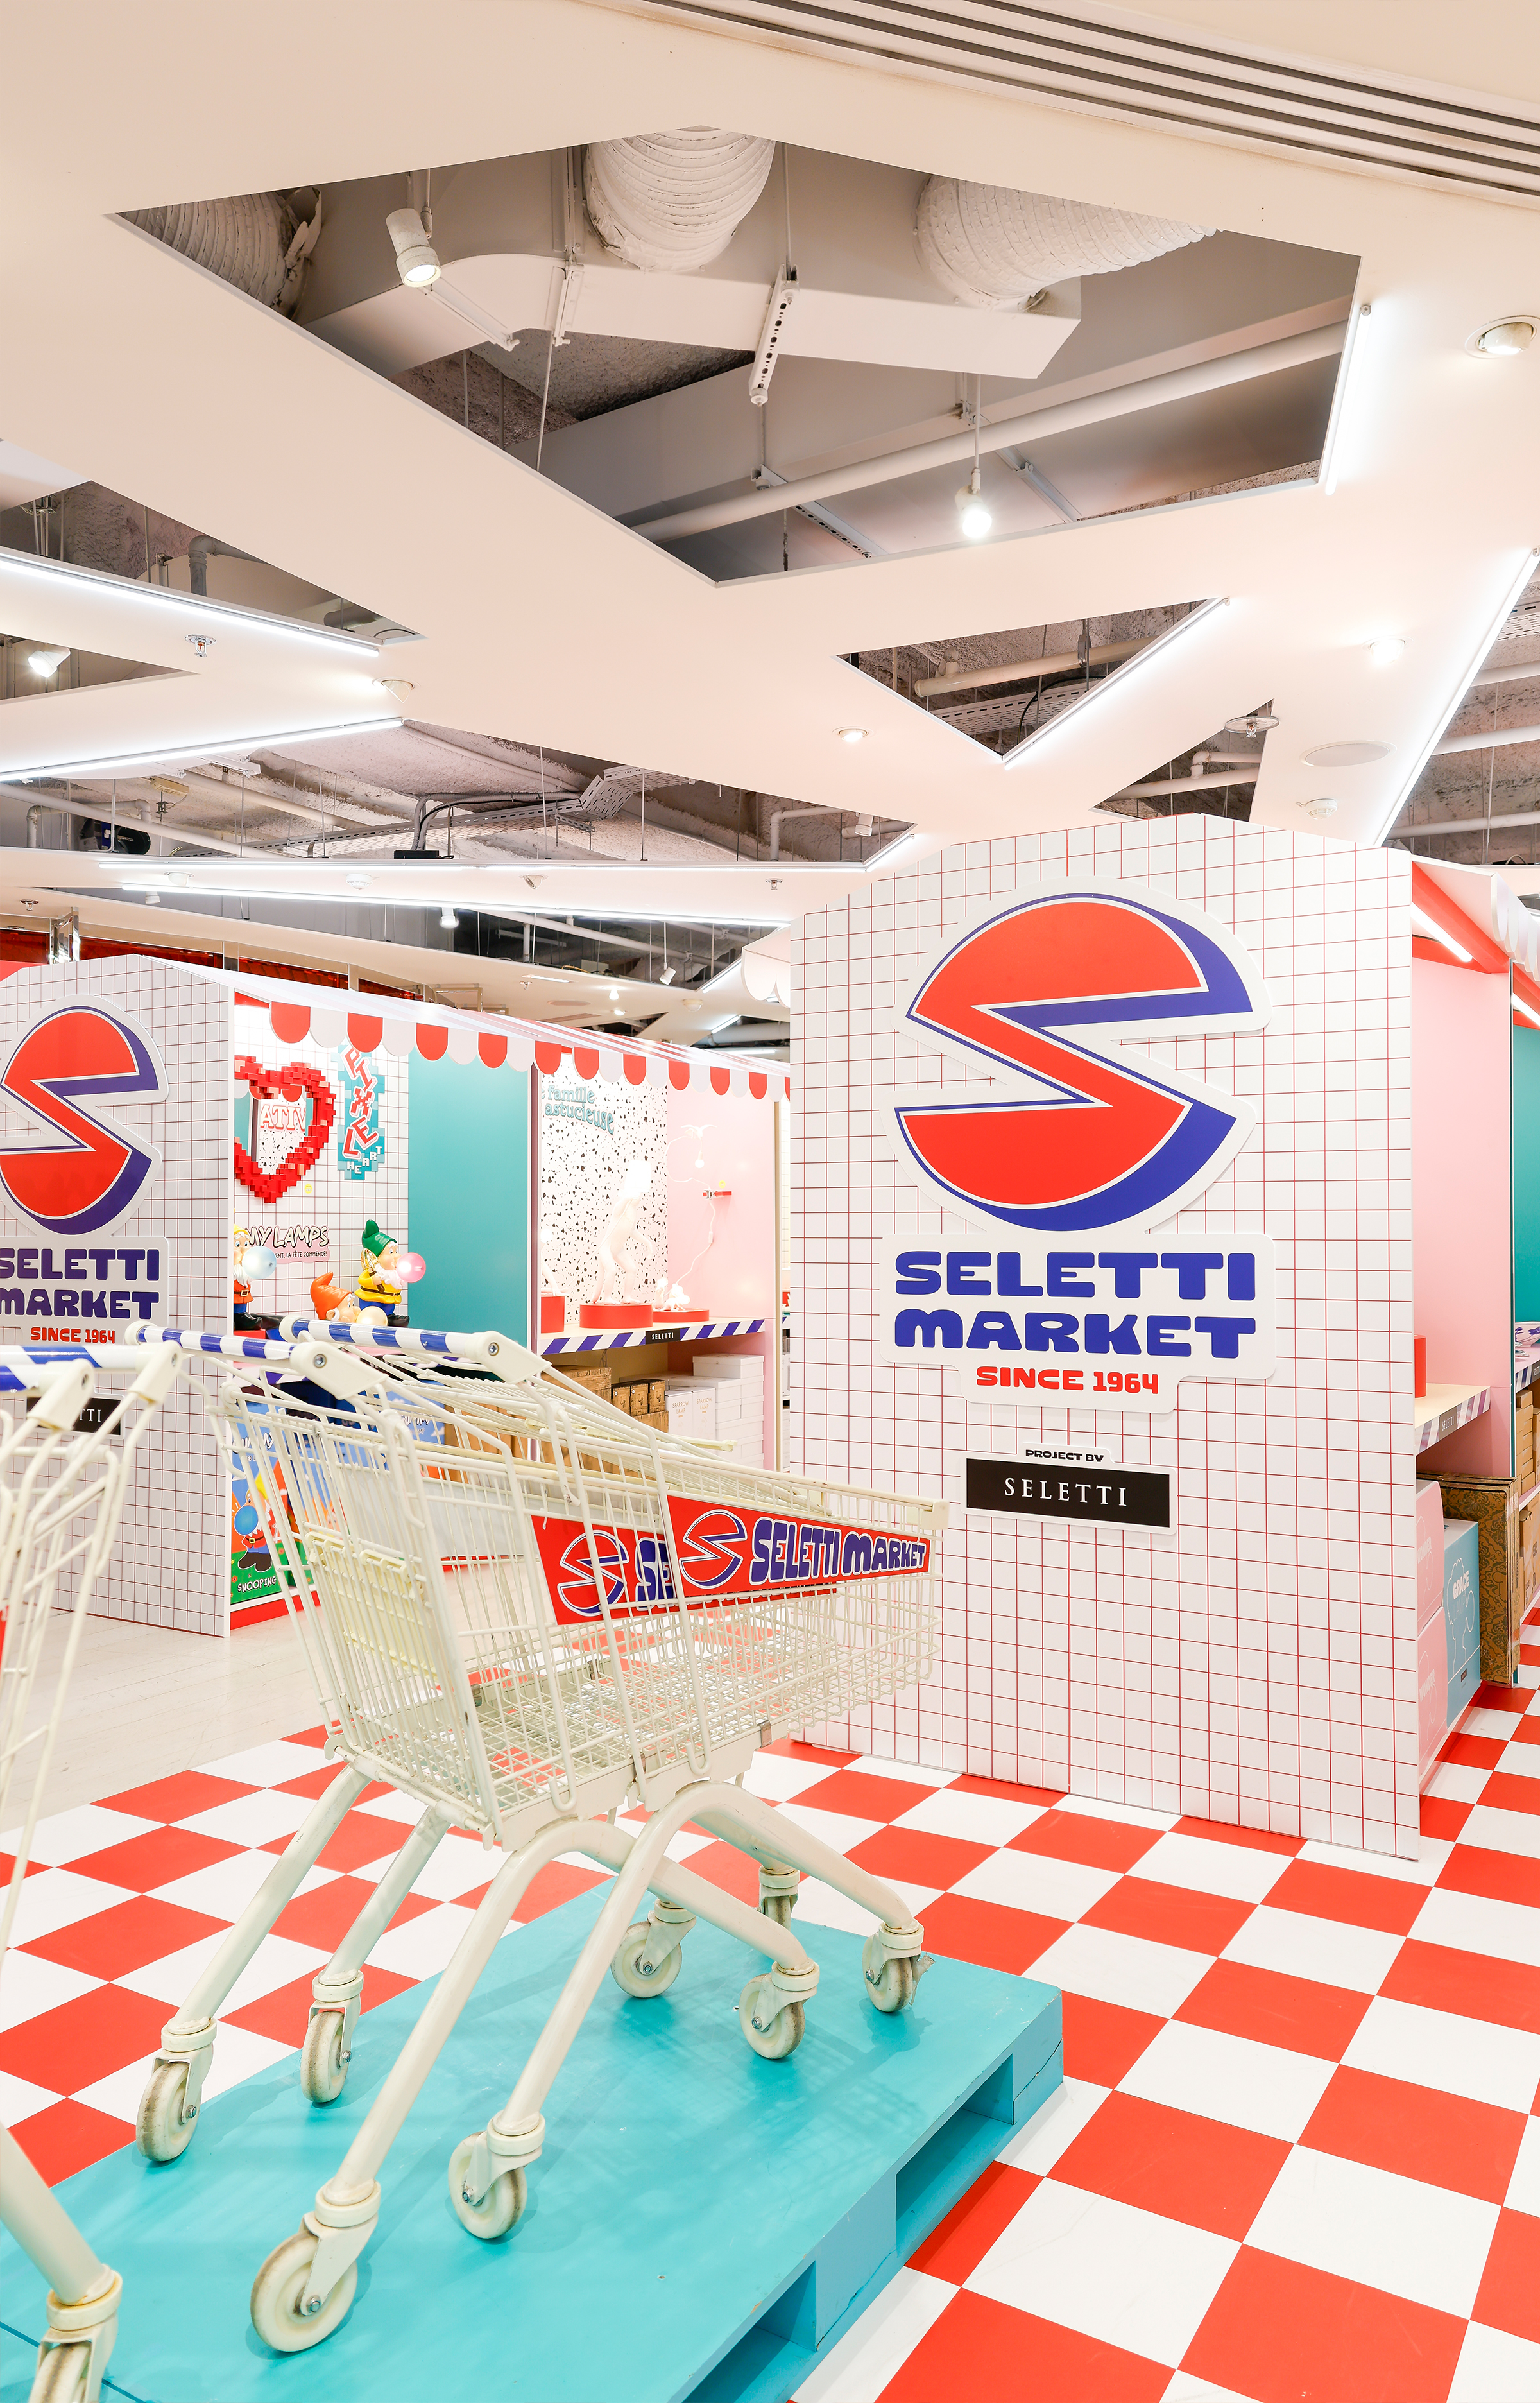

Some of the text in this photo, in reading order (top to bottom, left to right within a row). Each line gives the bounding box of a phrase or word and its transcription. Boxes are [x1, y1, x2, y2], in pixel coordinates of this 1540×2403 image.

[548, 1085, 595, 1103] famille
[545, 1102, 614, 1135] astucieuse
[347, 1146, 382, 1174] HEART
[273, 1225, 329, 1248] LAMPS
[0, 1248, 160, 1281] SELETTI
[896, 1250, 1256, 1301] SELETTI
[0, 1288, 160, 1320] MARKET
[30, 1327, 116, 1344] SINCE 1964
[651, 1332, 674, 1340] SELETTI
[894, 1308, 1256, 1359] MARKET
[976, 1366, 1159, 1395] SINCE 1964
[1442, 1415, 1454, 1431] SELETTI
[1025, 1449, 1104, 1463] PROJECT BY
[1005, 1477, 1127, 1507] SELETTI
[750, 1517, 841, 1585] SELETTI
[842, 1531, 927, 1577] MARKET
[237, 1576, 277, 1592] SNOOPING
[1453, 1570, 1469, 1599] GRACE
